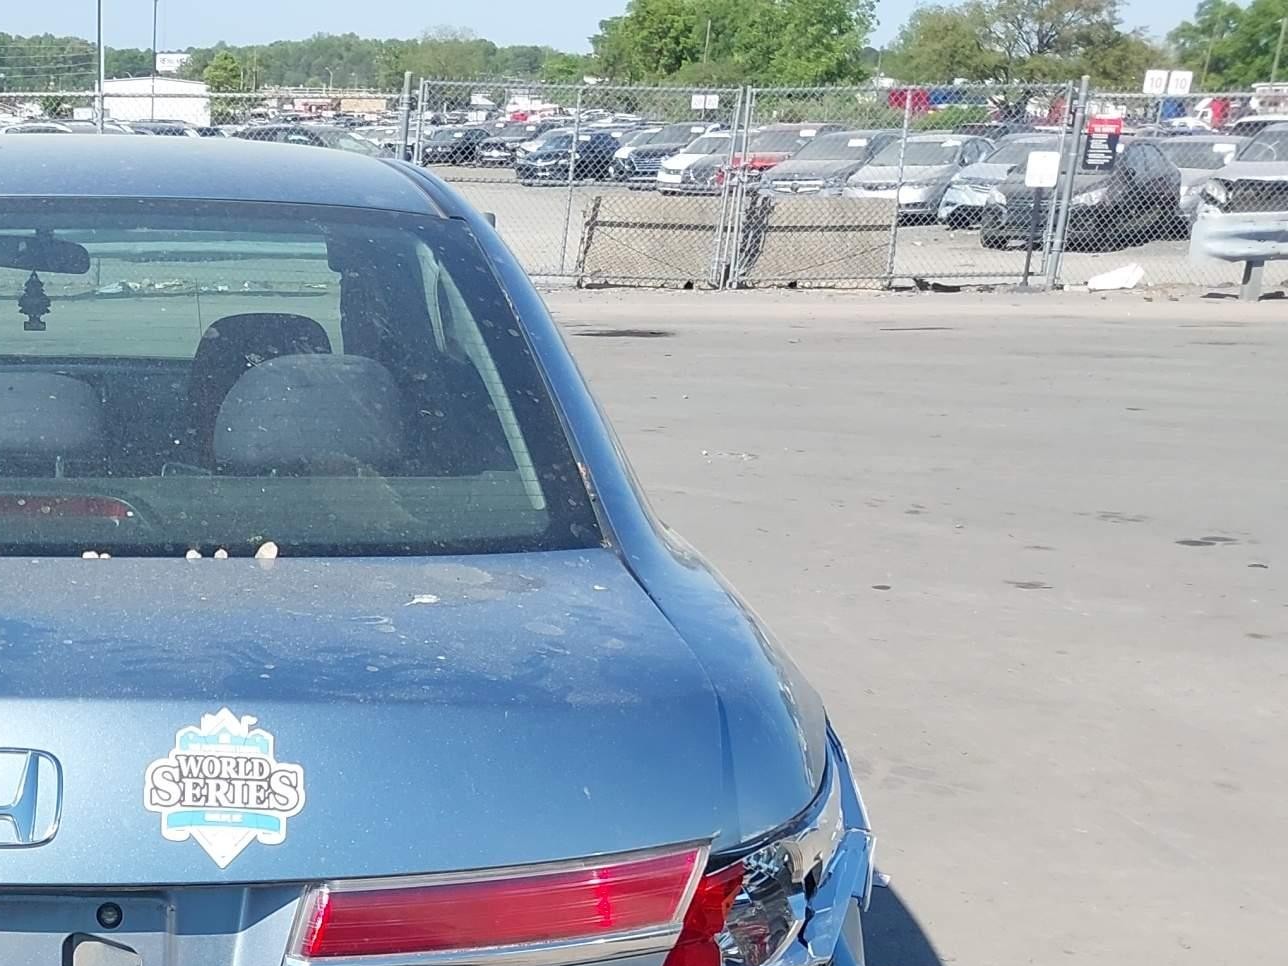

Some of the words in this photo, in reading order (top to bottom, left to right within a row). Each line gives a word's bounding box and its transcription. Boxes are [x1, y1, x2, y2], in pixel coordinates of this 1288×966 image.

[1150, 77, 1162, 89] 10
[1175, 78, 1187, 89] 10
[175, 754, 272, 781] WORLD
[149, 763, 300, 812] SERIES
